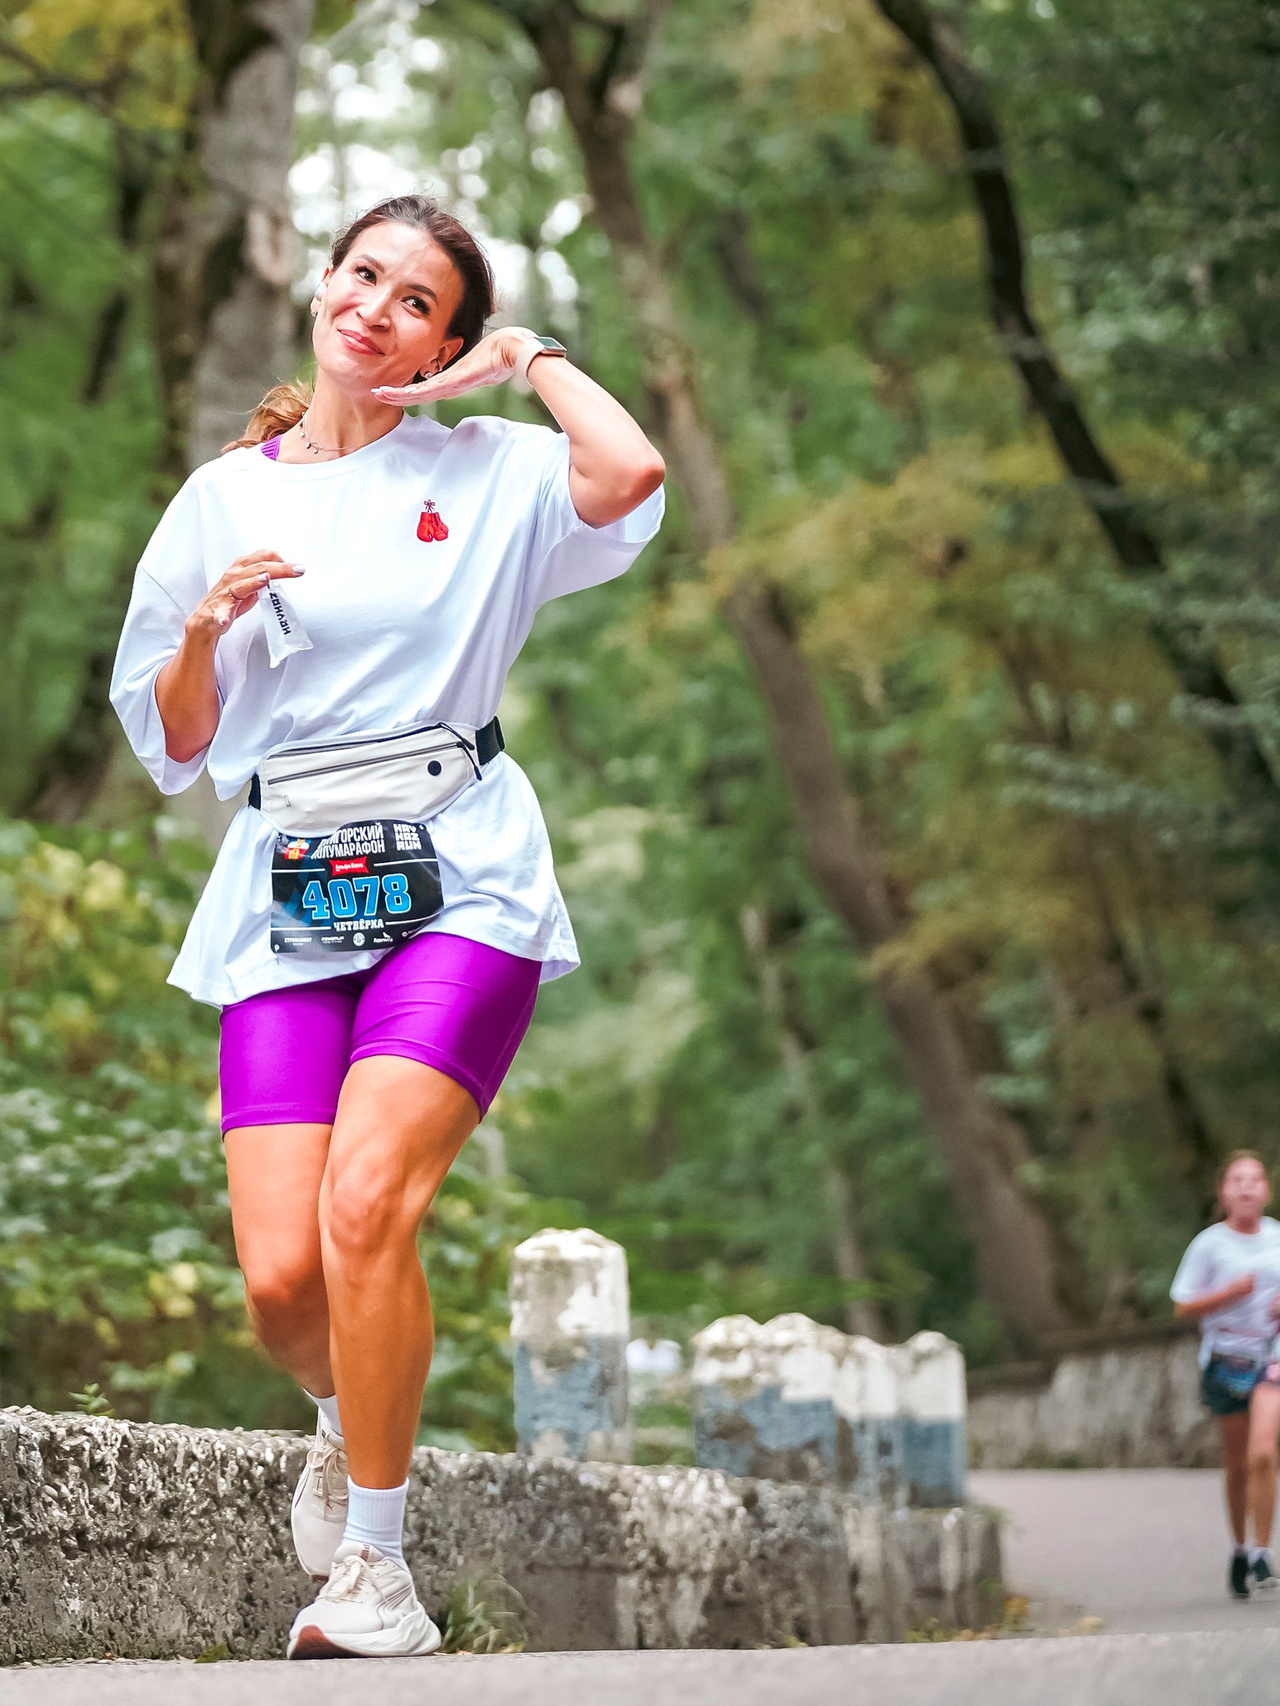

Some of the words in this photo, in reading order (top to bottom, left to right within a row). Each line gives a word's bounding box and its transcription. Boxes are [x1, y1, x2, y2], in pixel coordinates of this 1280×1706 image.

[267, 585, 292, 635] HAYHAZ
[396, 840, 422, 851] RUN
[302, 873, 412, 920] 4078
[333, 919, 384, 932] ЧЕТВЁРКА
